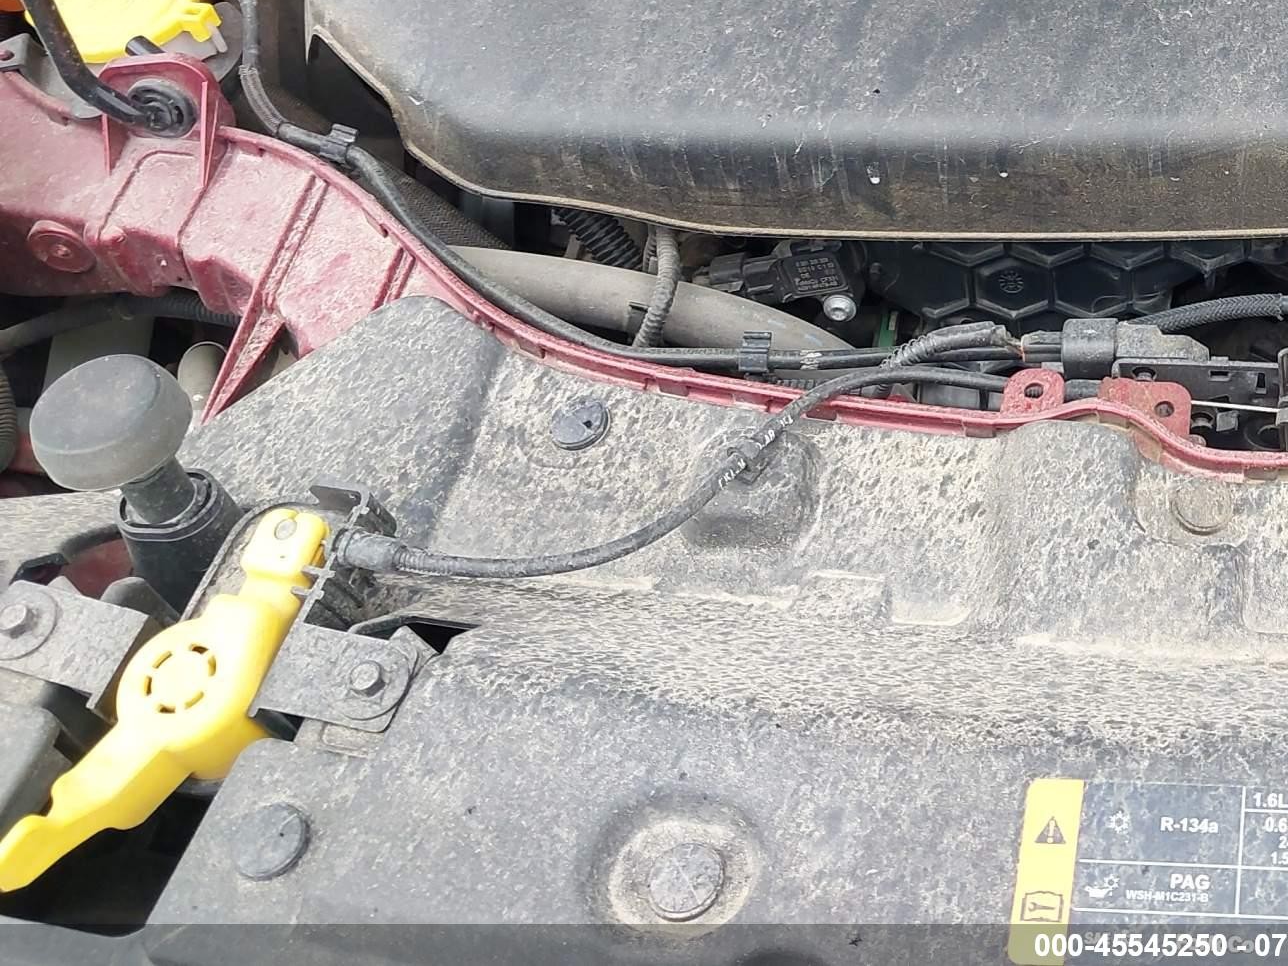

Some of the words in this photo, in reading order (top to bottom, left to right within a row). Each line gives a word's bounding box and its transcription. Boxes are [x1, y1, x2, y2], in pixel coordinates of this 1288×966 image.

[1253, 793, 1288, 809] 1.6L
[1160, 817, 1219, 834] R-134a
[1170, 873, 1211, 890] PAG
[1126, 890, 1209, 902] WSH-M1C231-B
